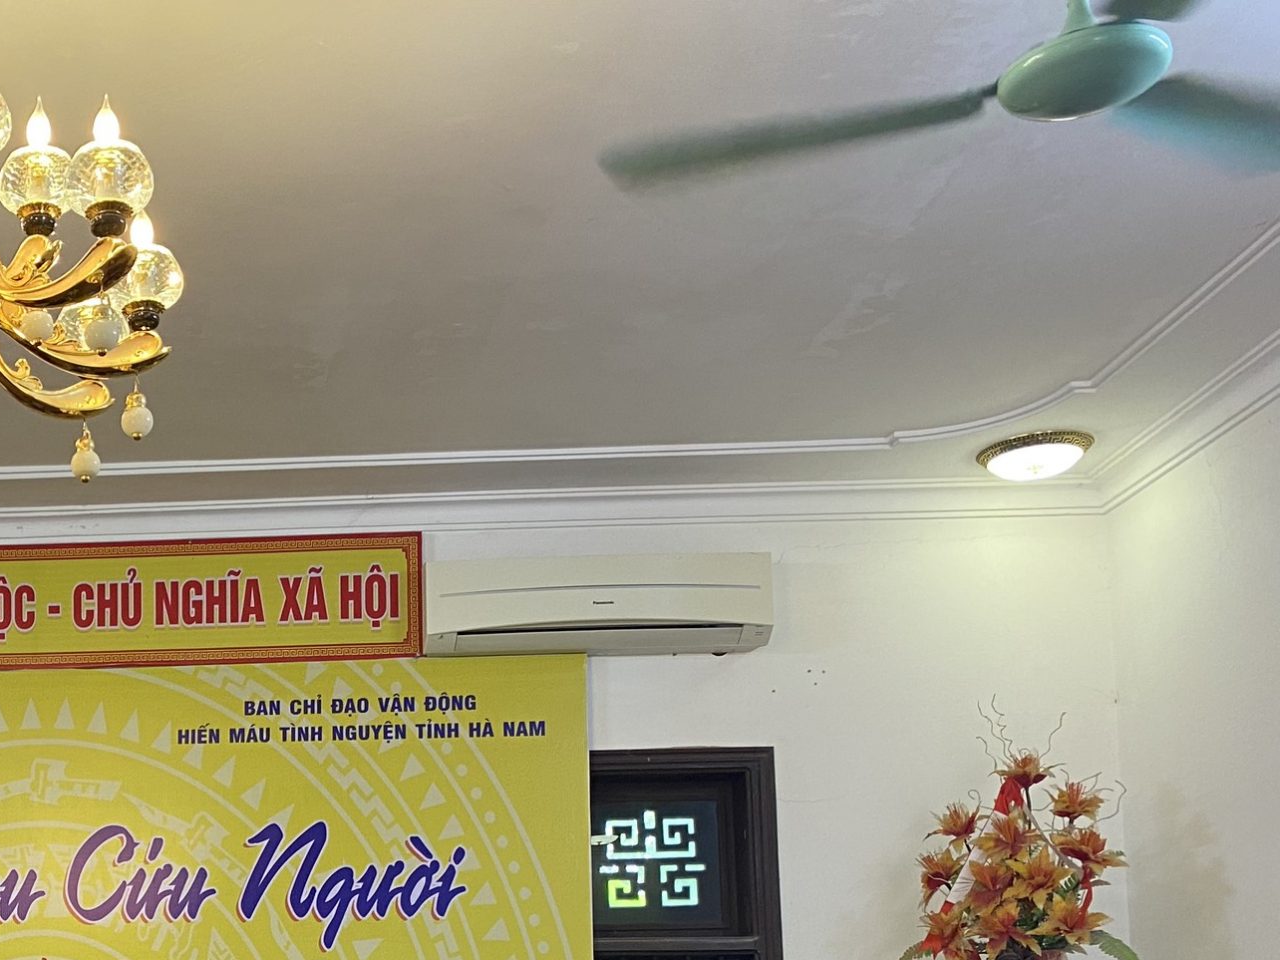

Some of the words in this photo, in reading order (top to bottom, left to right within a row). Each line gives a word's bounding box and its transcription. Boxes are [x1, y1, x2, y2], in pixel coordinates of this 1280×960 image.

[73, 567, 142, 629] CHỦ
[155, 569, 265, 626] NGHĨA
[279, 566, 329, 623] XÃ
[339, 564, 399, 629] HỘI
[244, 700, 280, 716] BAN
[289, 694, 322, 715] CHỈ
[331, 698, 369, 719] ĐẠO
[377, 694, 415, 717] VẬN
[424, 693, 477, 716] ĐỘNG
[177, 722, 220, 745] HIẾN
[229, 723, 271, 744] MÁU
[279, 723, 322, 743] TÌNH
[331, 720, 407, 744] NGUYỆN
[415, 720, 460, 740] TỈNH
[468, 719, 495, 739] HÀ
[503, 720, 546, 737] NAM
[66, 823, 217, 923] Cứu
[239, 820, 466, 951] Người
